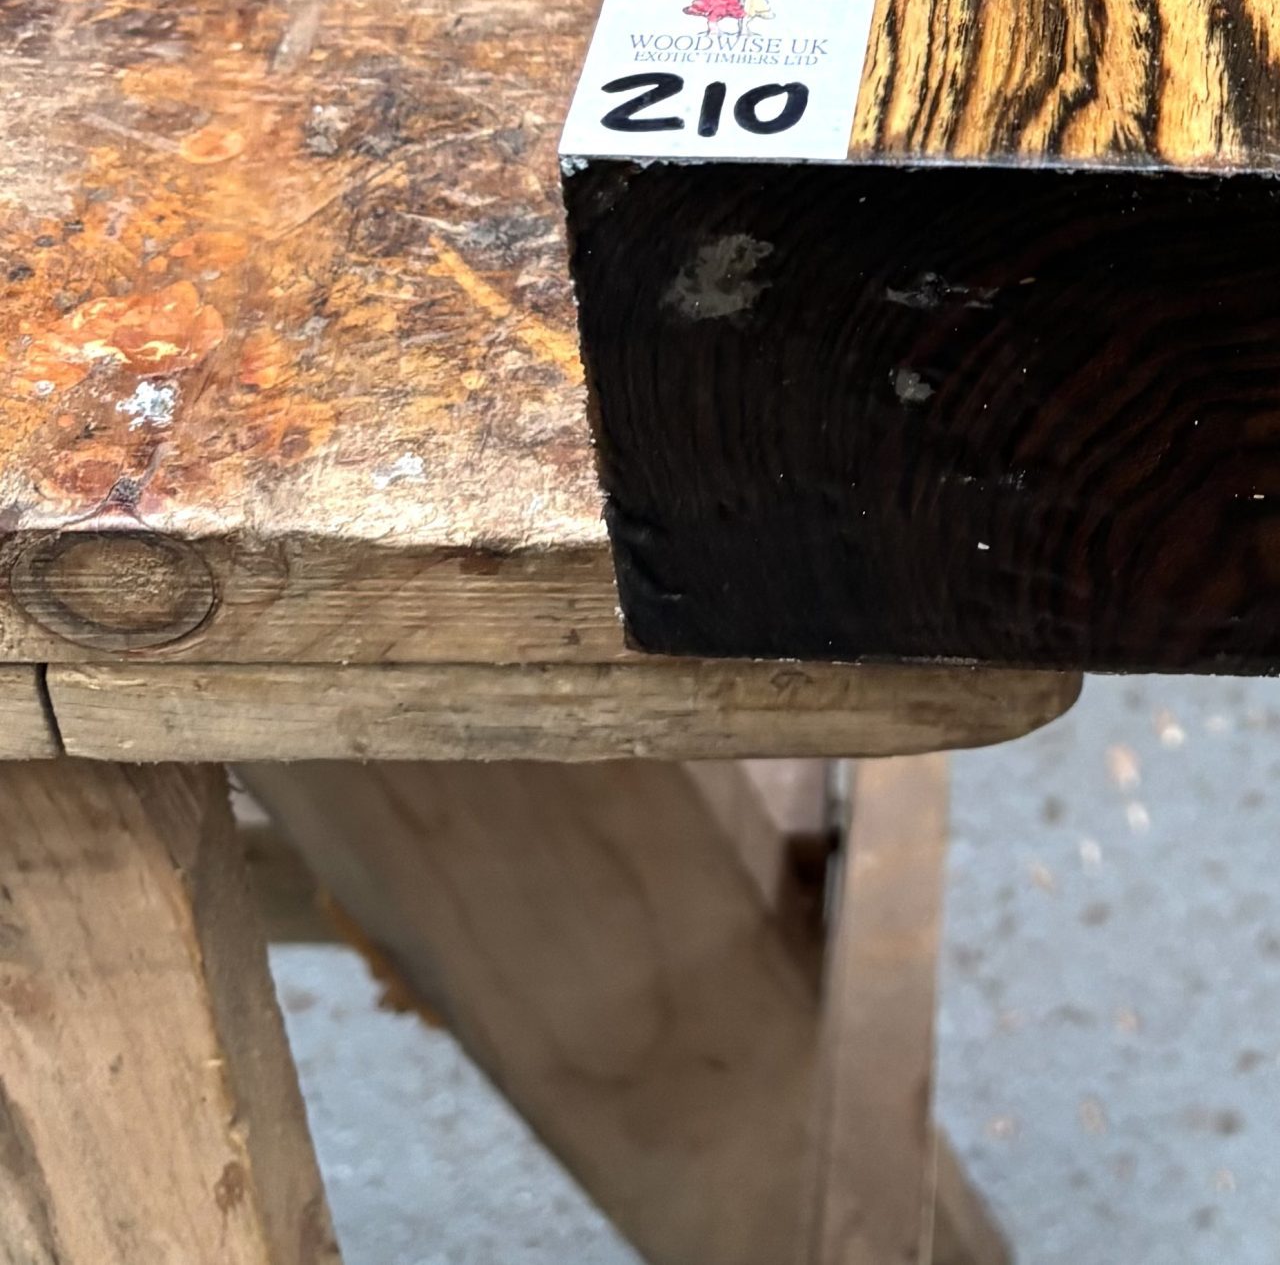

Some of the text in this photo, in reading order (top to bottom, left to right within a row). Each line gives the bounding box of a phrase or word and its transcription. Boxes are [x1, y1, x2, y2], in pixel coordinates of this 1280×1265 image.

[630, 34, 829, 55] WOODWISE UK
[634, 50, 819, 66] EXOTIC TIMBERS LTD
[600, 72, 809, 137] 210
